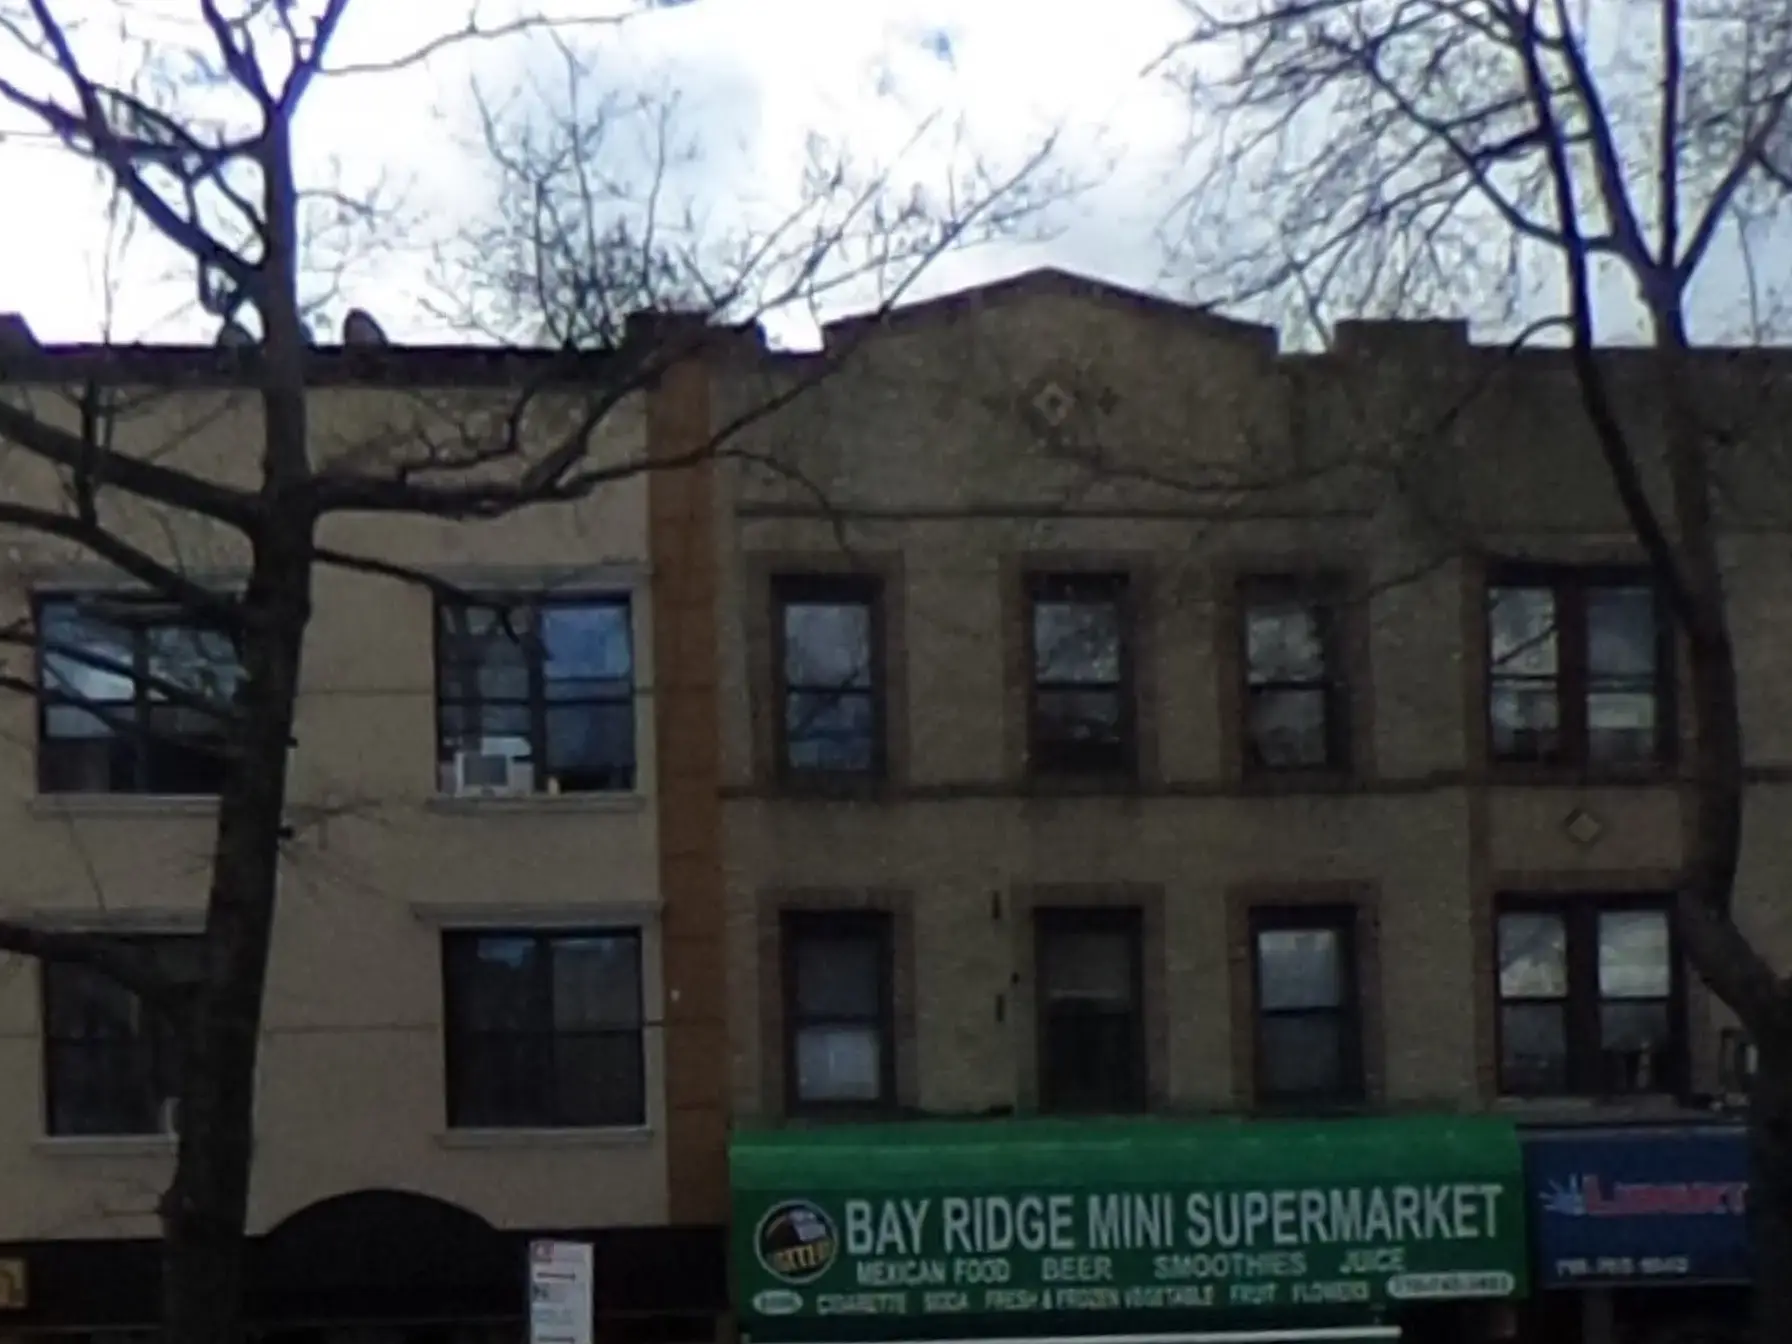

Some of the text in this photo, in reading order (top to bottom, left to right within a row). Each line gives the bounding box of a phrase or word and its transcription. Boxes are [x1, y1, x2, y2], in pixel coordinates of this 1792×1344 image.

[844, 1184, 1503, 1254] BAY RIDGE MINI SUPERMARKET
[856, 1246, 1406, 1286] MEXICAN FOOD BEER SMOOTHIES JUICE
